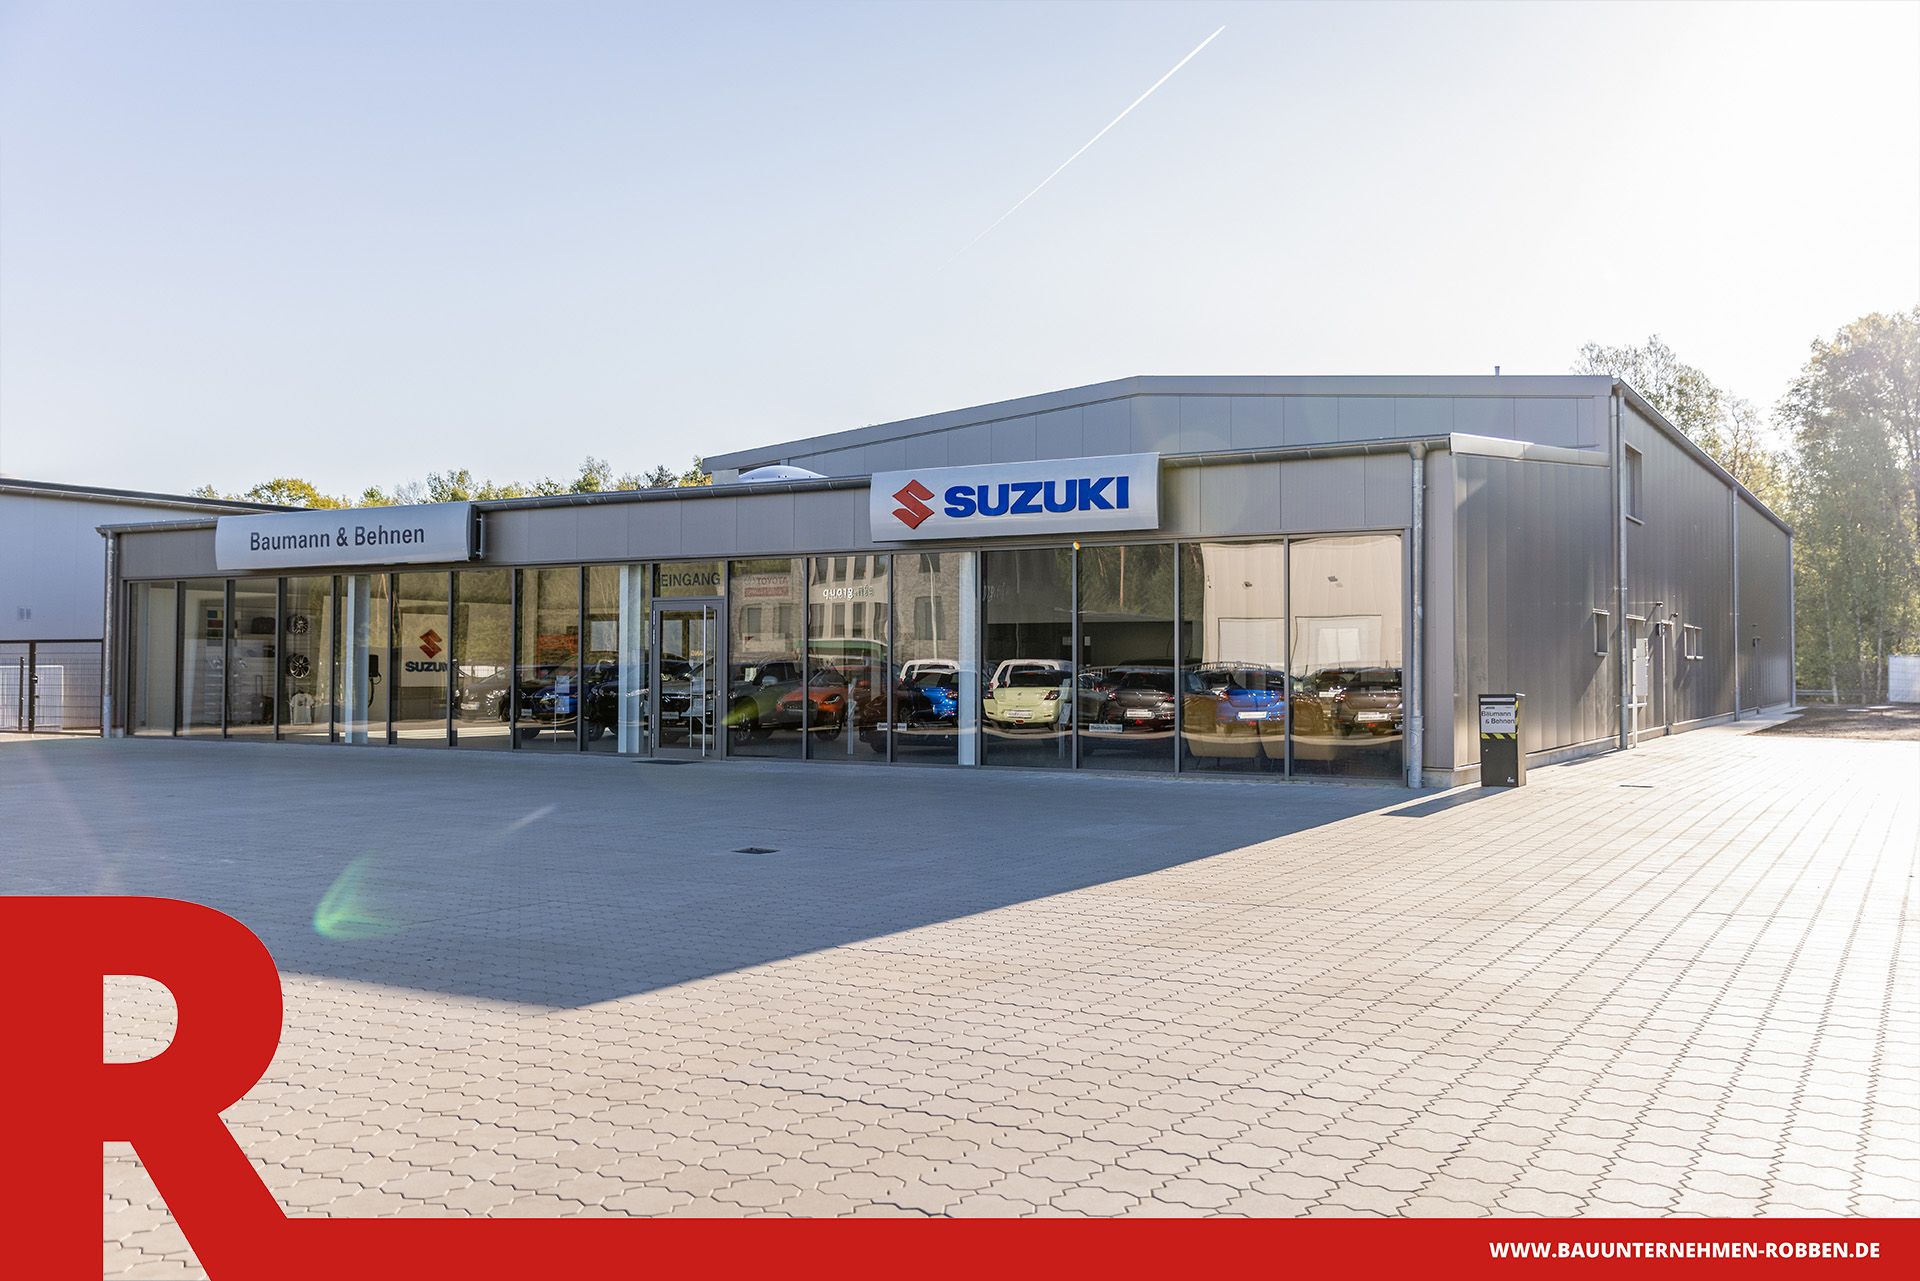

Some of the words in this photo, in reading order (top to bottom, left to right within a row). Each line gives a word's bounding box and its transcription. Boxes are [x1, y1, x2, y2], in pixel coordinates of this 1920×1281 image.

[944, 476, 1129, 518] SUZUKI
[250, 531, 330, 551] Baumann
[336, 526, 349, 547] &
[354, 525, 425, 546] Behnen
[660, 572, 721, 587] EINGANG
